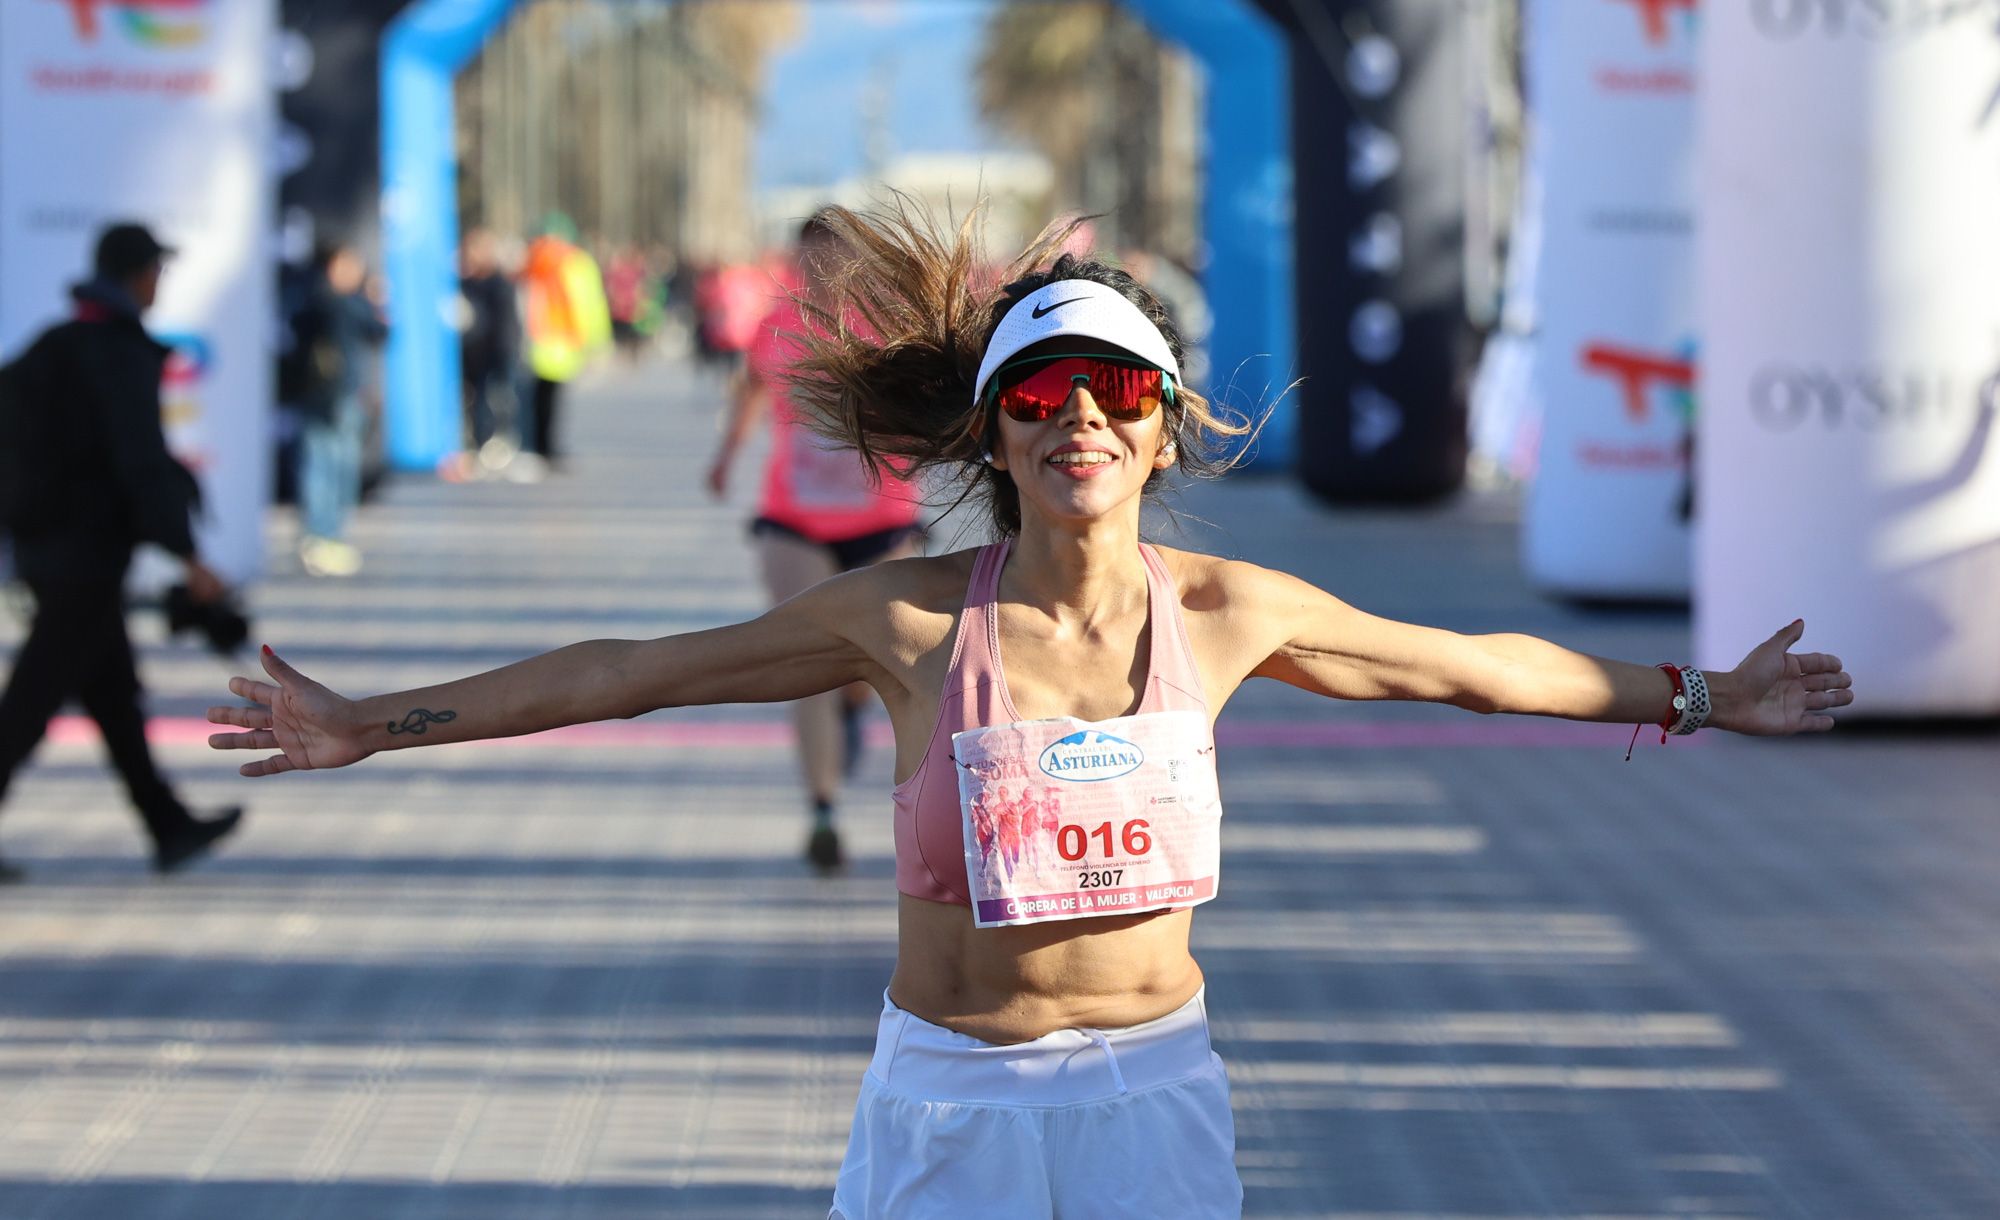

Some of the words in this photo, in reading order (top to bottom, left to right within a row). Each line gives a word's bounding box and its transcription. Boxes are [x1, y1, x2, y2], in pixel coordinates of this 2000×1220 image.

[1048, 752, 1138, 771] ASTURIANA
[1057, 819, 1151, 861] 016
[1078, 870, 1123, 888] 2307
[1007, 900, 1058, 914] CARRERA
[1061, 897, 1076, 909] DE
[1079, 896, 1094, 908] LA
[1098, 893, 1136, 906] MUJER
[1145, 886, 1194, 899] VALENCIA
